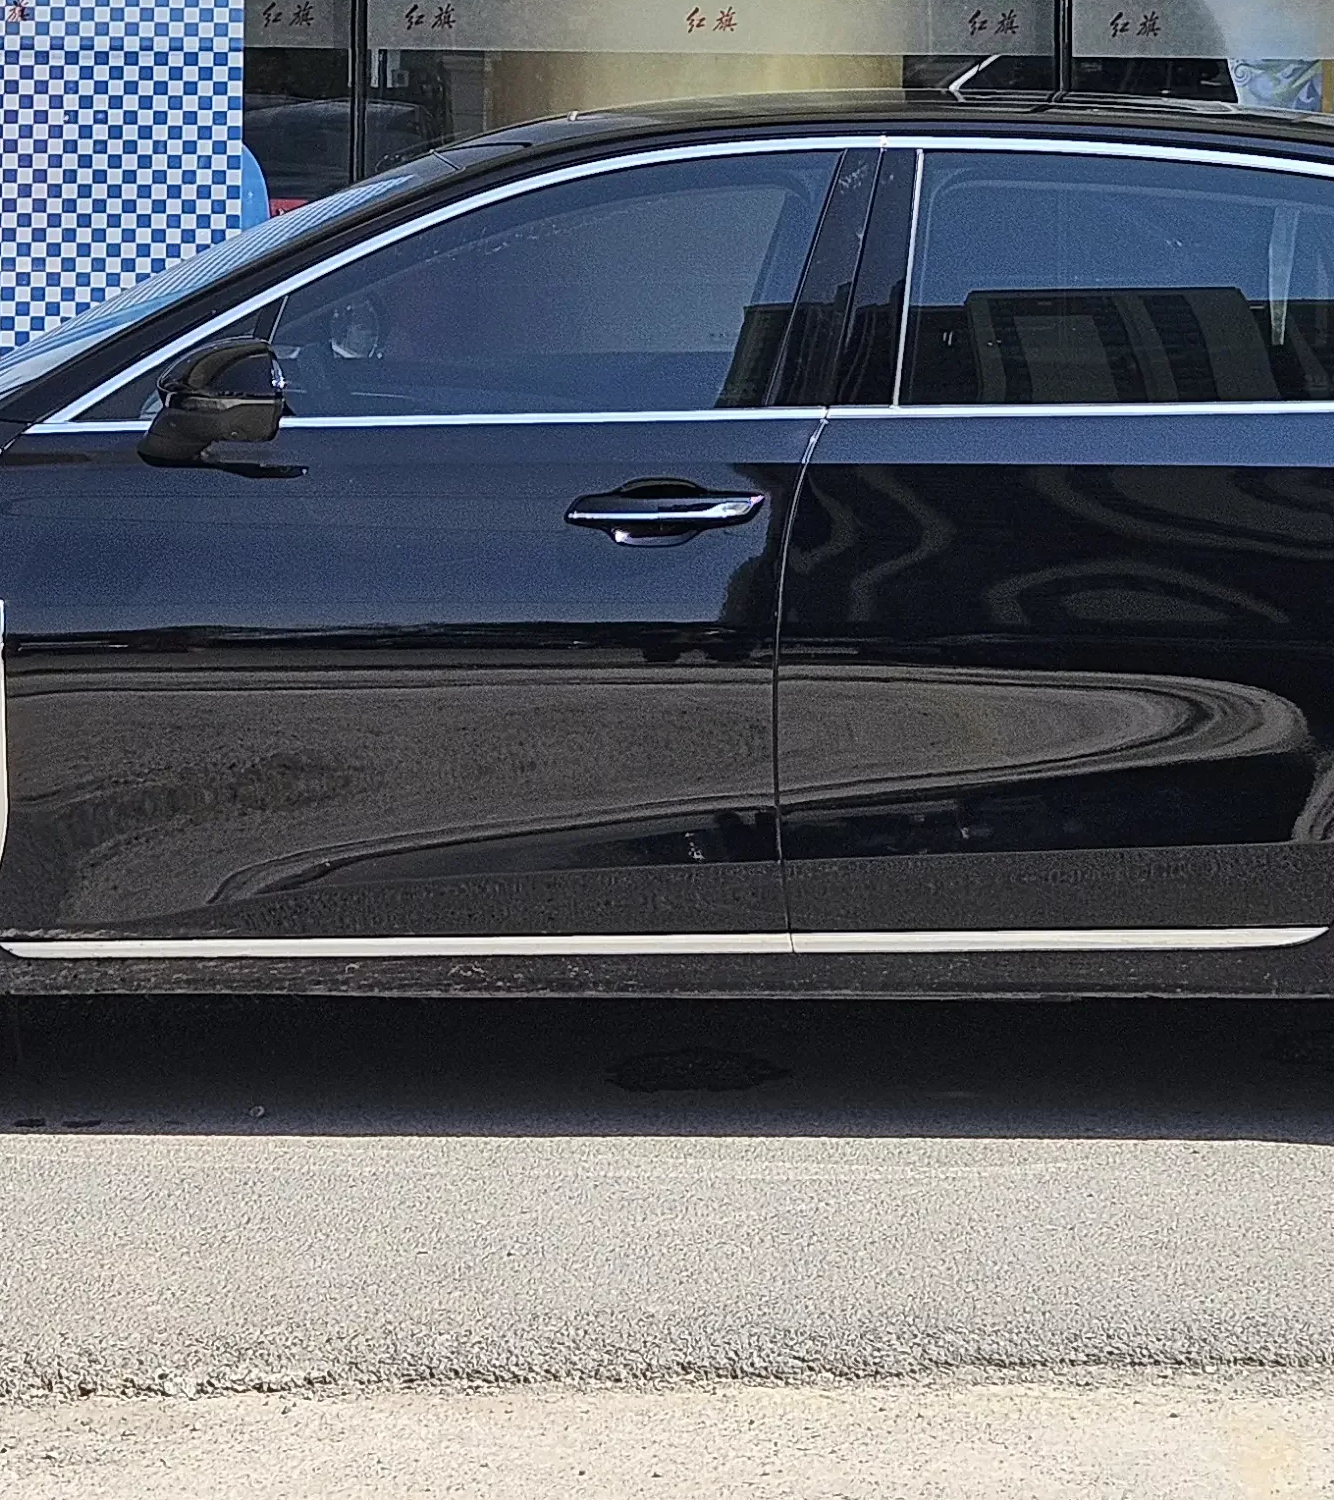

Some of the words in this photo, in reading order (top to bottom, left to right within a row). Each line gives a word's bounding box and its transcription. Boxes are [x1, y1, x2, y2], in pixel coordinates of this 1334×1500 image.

[262, 1, 315, 27] 红旗
[405, 4, 457, 31] 红旗
[686, 7, 738, 32] 红旗
[969, 9, 1020, 36] 红旗
[1110, 10, 1161, 38] 红旗
